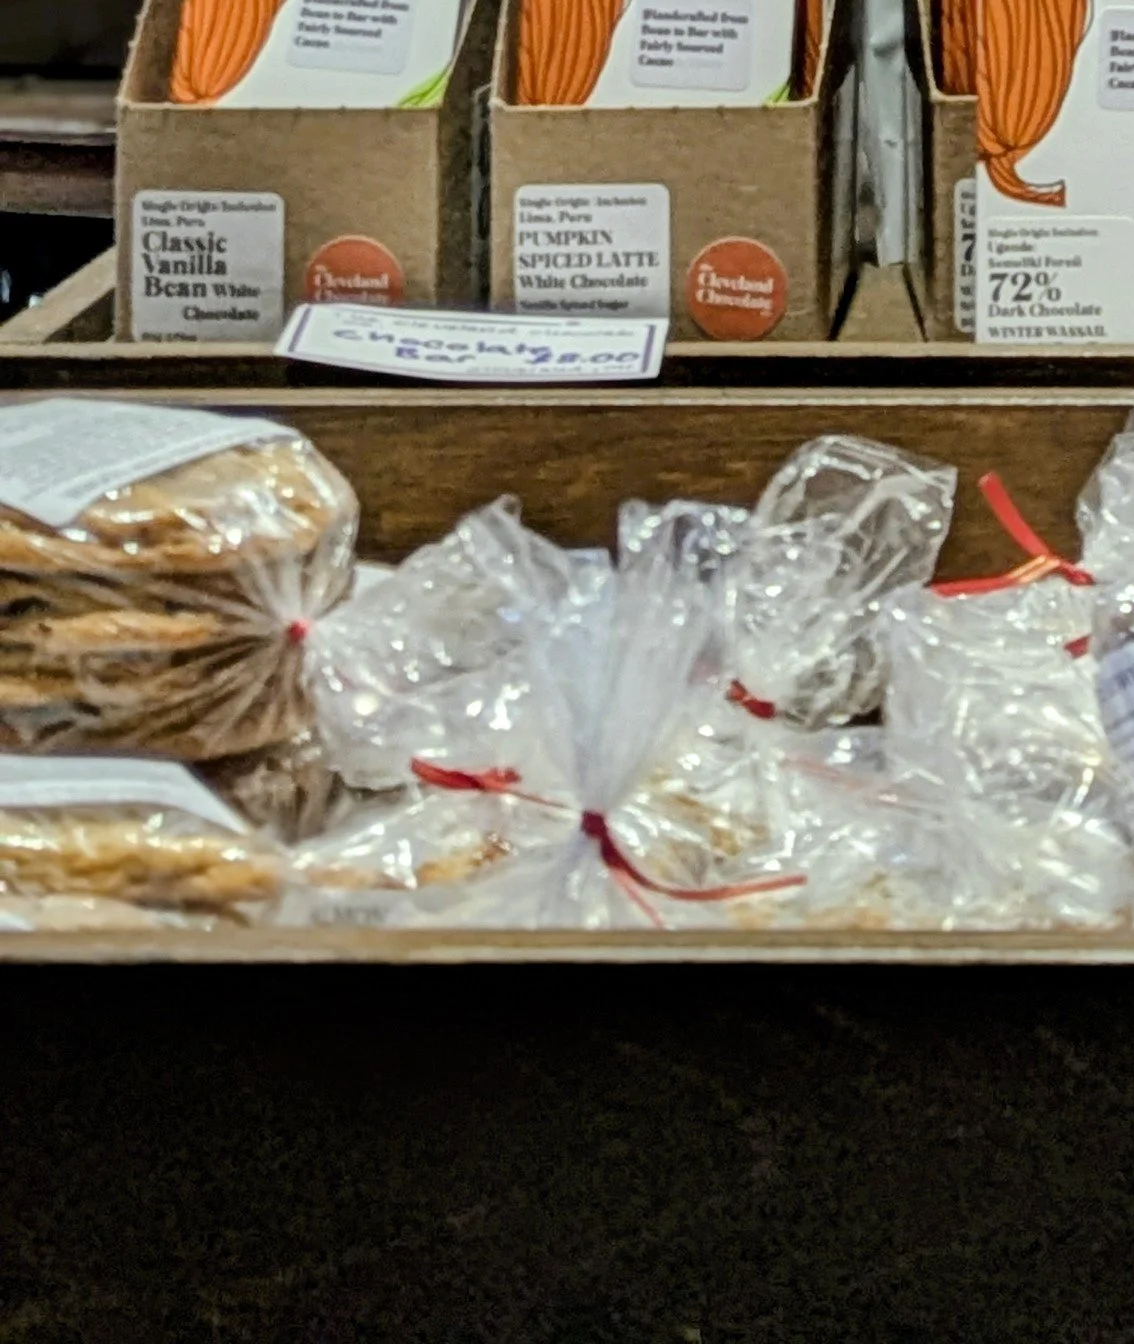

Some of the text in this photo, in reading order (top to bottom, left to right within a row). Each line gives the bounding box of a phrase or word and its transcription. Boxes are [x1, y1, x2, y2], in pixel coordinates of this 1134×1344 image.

[381, 0, 409, 11] from
[301, 7, 397, 25] Bean to Bar with
[721, 12, 749, 24] from
[298, 21, 382, 38] Fairly Sourced
[642, 24, 738, 39] Bean to Bar with
[294, 35, 330, 48] Cacao
[640, 40, 724, 54] Fairly Sourced
[638, 55, 674, 66] Cacao
[558, 210, 593, 223] Peru
[142, 231, 228, 253] Classic
[518, 230, 613, 246] PUMPKIN
[142, 252, 228, 275] Vanilla
[518, 250, 660, 269] SPICED LATTE
[144, 275, 260, 297] Bean White
[312, 271, 390, 290] Cleveland
[518, 272, 648, 289] White Chocolate
[697, 272, 776, 295] Cleveland
[989, 271, 1062, 302] 72%
[695, 288, 775, 310] Chocolate
[182, 306, 260, 321] Chocolate
[988, 301, 1103, 318] Dark Chocolate
[988, 325, 1043, 339] WINTER
